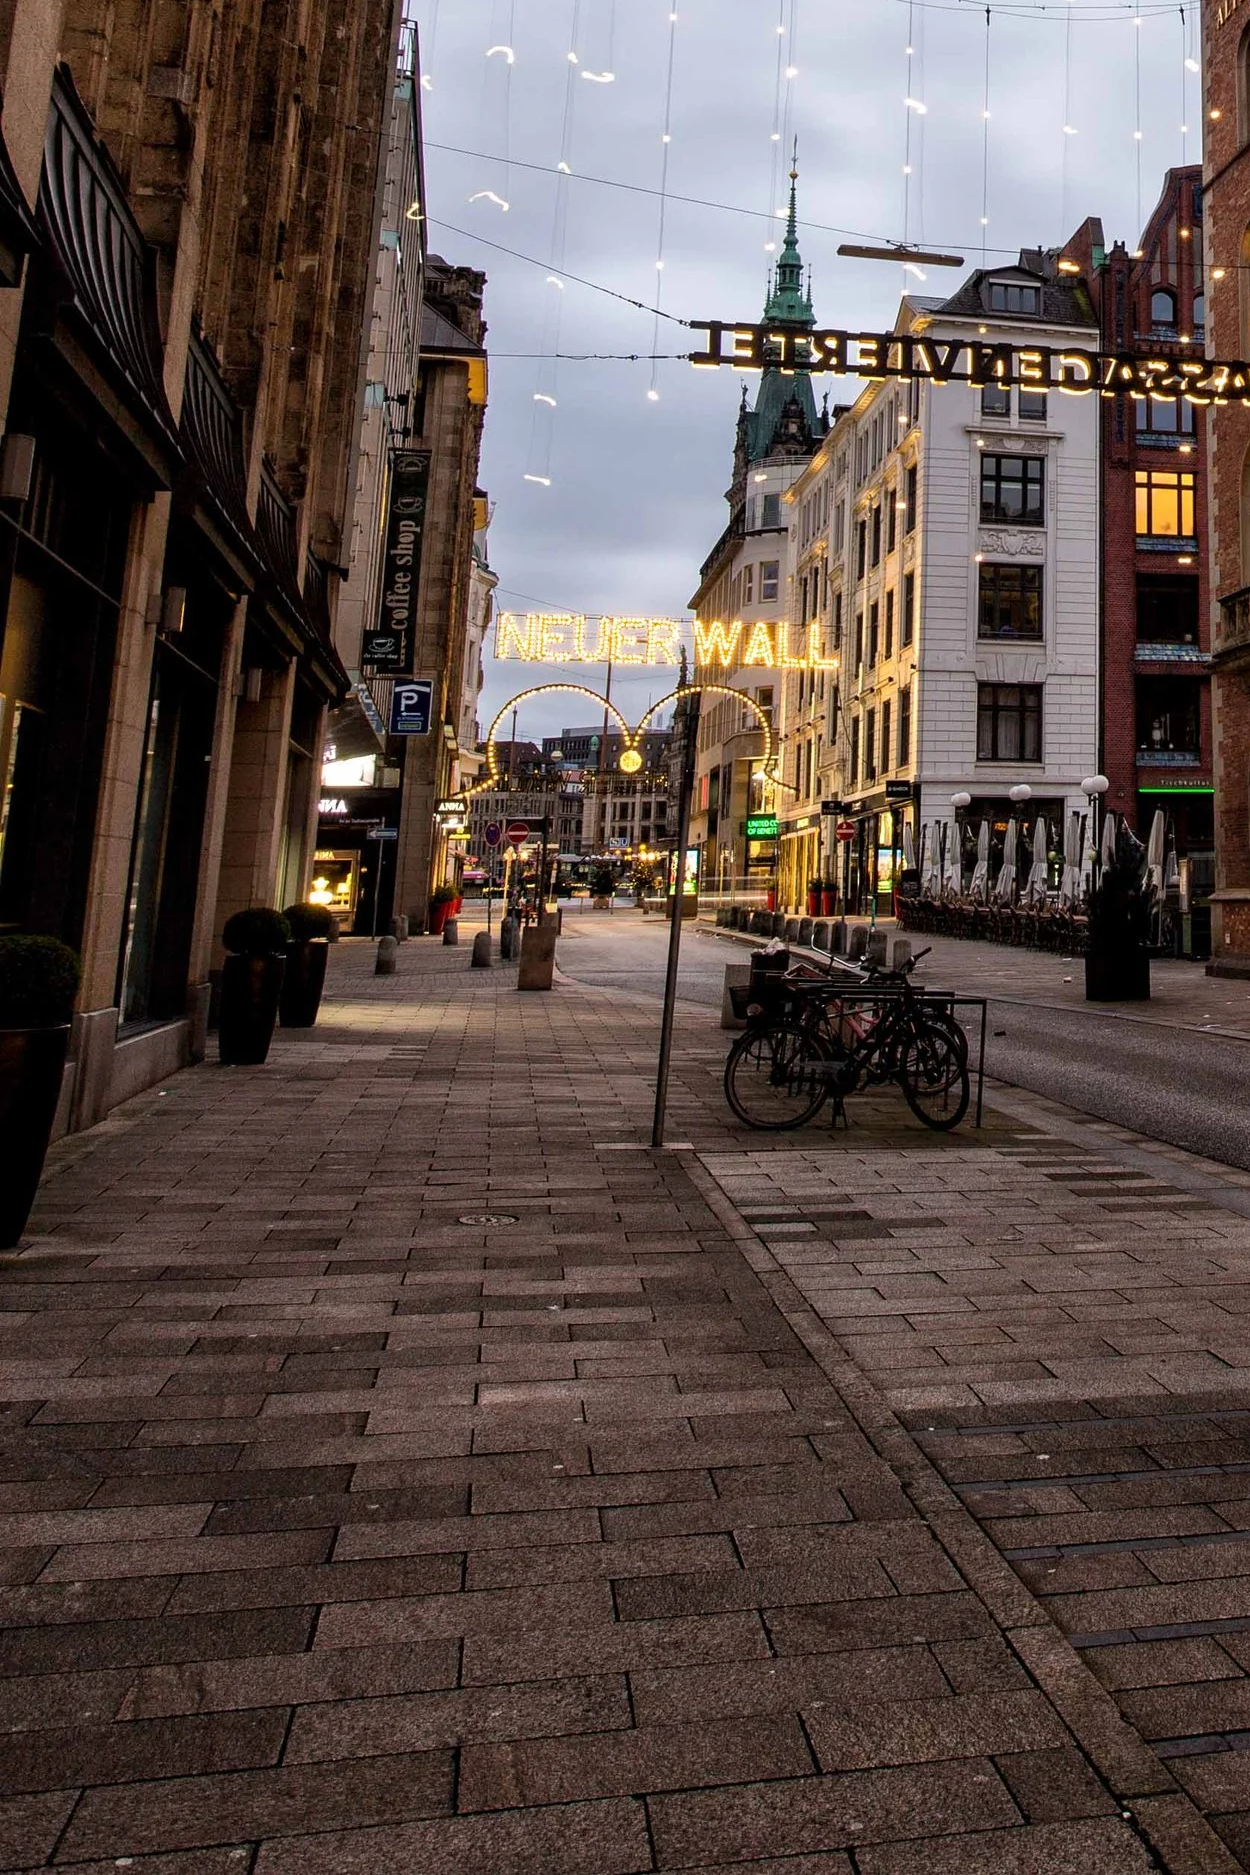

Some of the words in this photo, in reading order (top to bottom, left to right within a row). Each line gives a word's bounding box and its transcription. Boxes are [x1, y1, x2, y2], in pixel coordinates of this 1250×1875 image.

[390, 520, 421, 566] shop
[386, 571, 412, 630] coffee
[498, 612, 680, 665] NEUER
[692, 619, 840, 670] WALL
[400, 692, 418, 712] P
